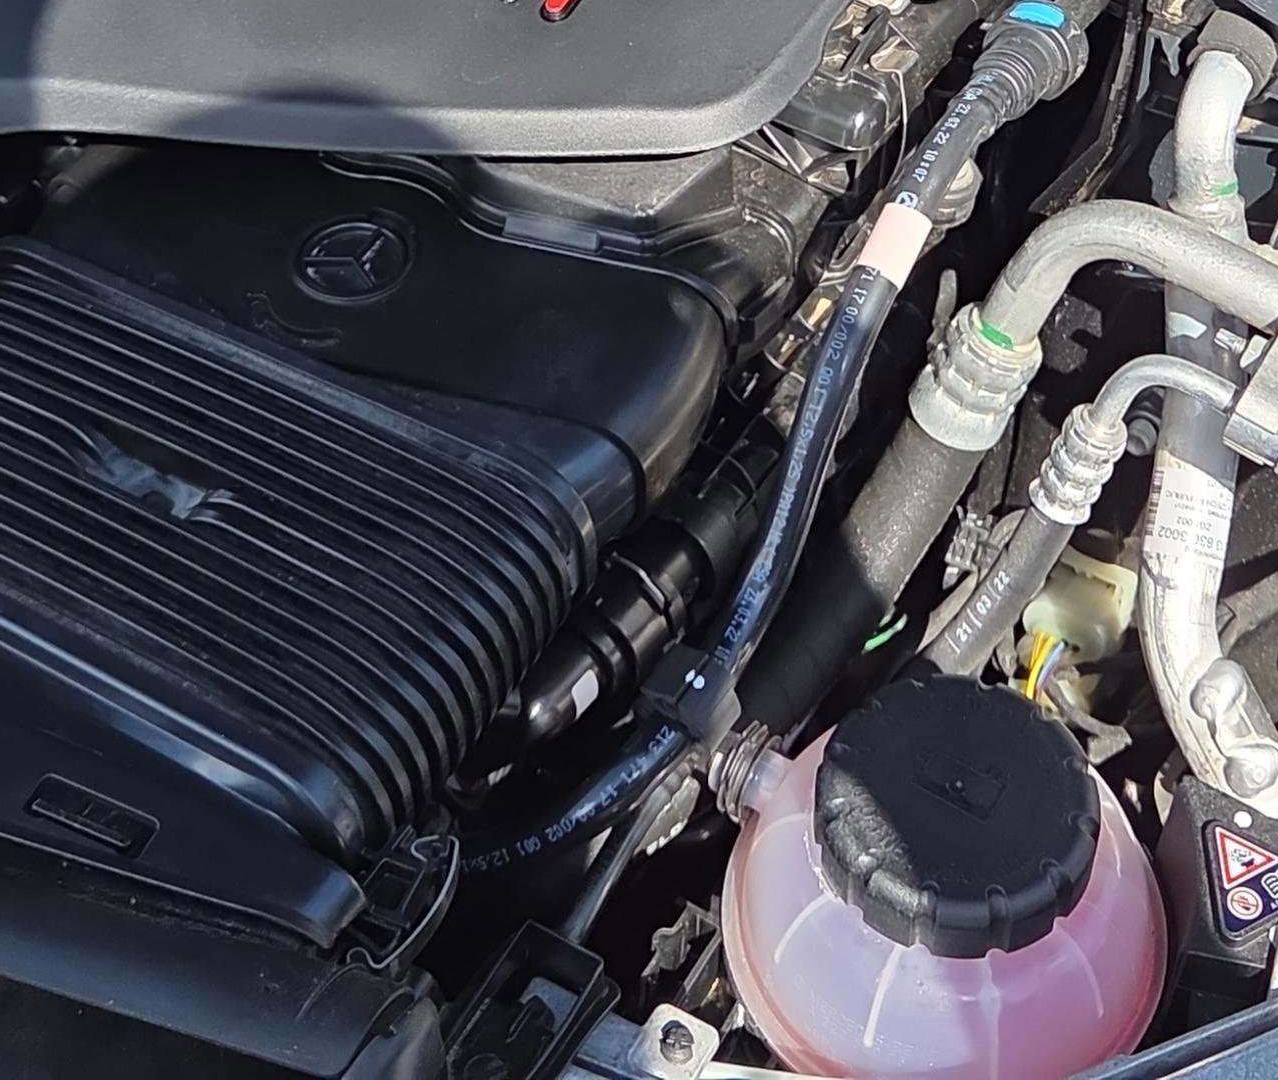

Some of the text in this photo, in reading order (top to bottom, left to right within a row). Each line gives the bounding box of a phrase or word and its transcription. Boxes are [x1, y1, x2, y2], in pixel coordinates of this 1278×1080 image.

[860, 264, 878, 282] 71
[850, 286, 868, 305] 17
[1156, 525, 1187, 542] 3002
[648, 725, 677, 754] 213
